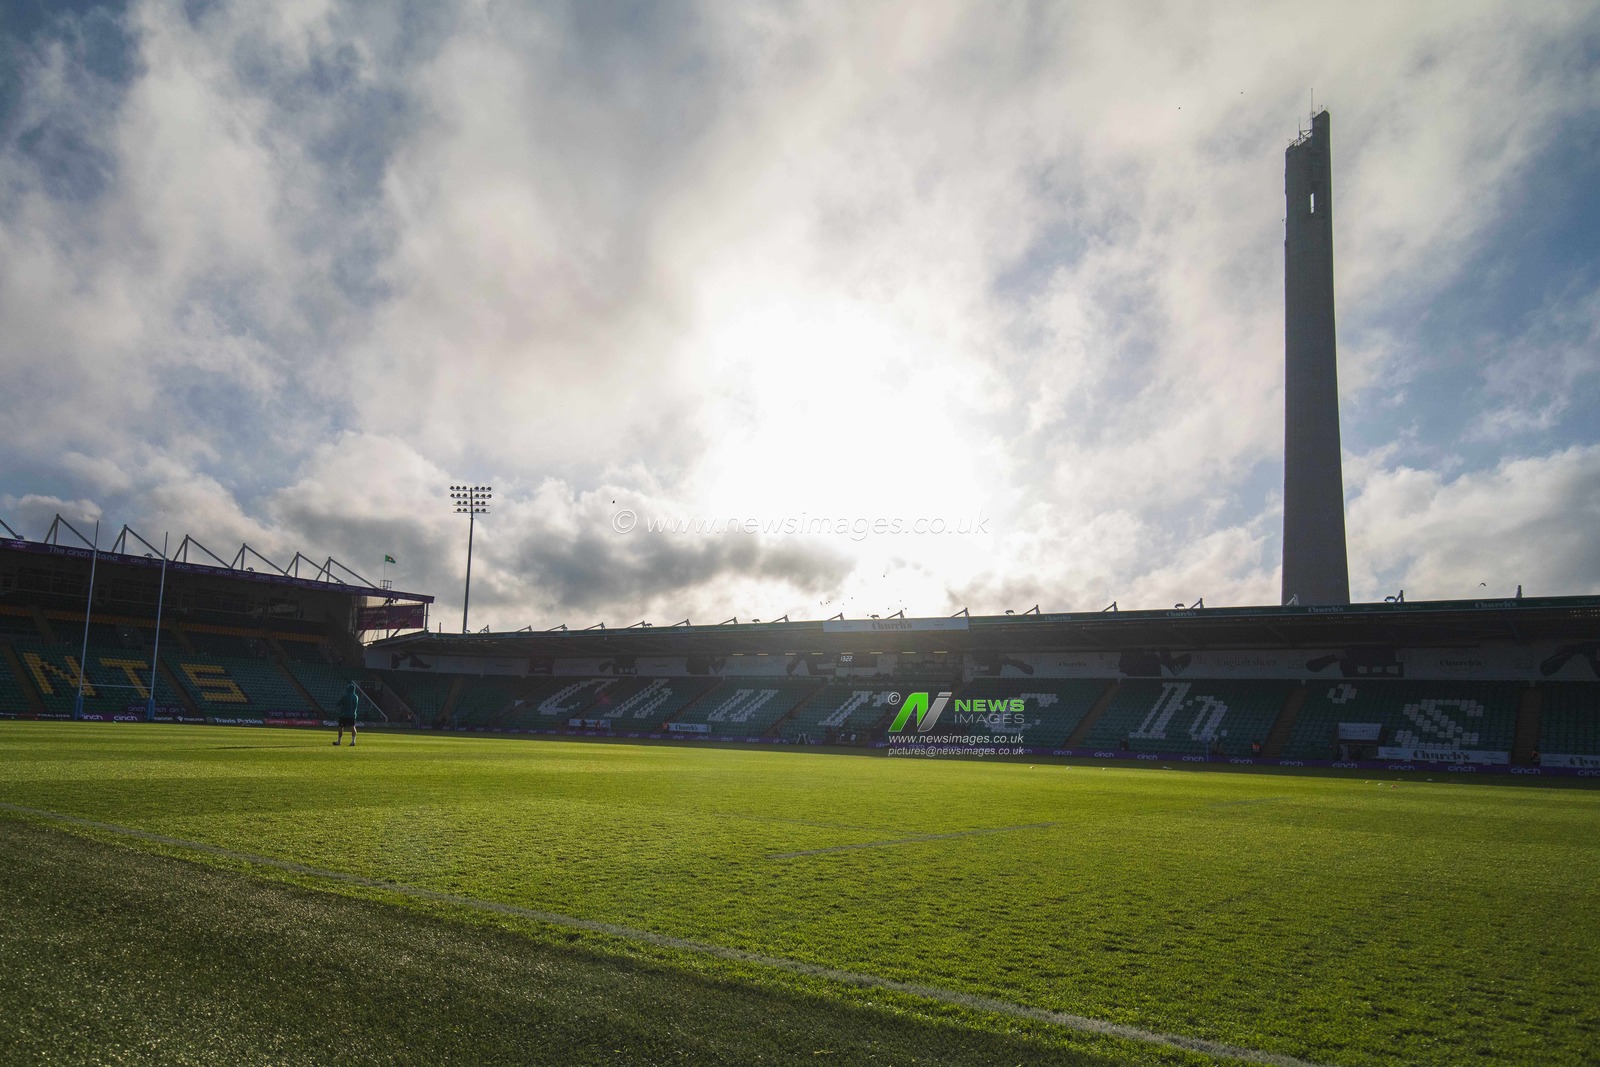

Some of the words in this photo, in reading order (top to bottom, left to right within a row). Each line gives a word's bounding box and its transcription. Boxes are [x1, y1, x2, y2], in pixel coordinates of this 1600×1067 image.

[48, 545, 65, 555] The
[67, 547, 91, 558] cinch
[174, 563, 191, 571] cinch
[1474, 601, 1517, 609] Church's
[871, 620, 913, 630] Church's
[1217, 656, 1250, 670] English
[1053, 749, 1072, 757] cinch
[1094, 750, 1114, 758] cinch
[1137, 753, 1158, 761] cinch
[1413, 750, 1471, 761] Church's
[1230, 757, 1252, 765] cinch
[1332, 761, 1358, 769] cinch
[1447, 765, 1476, 773] cinch
[1510, 767, 1541, 775] cinch
